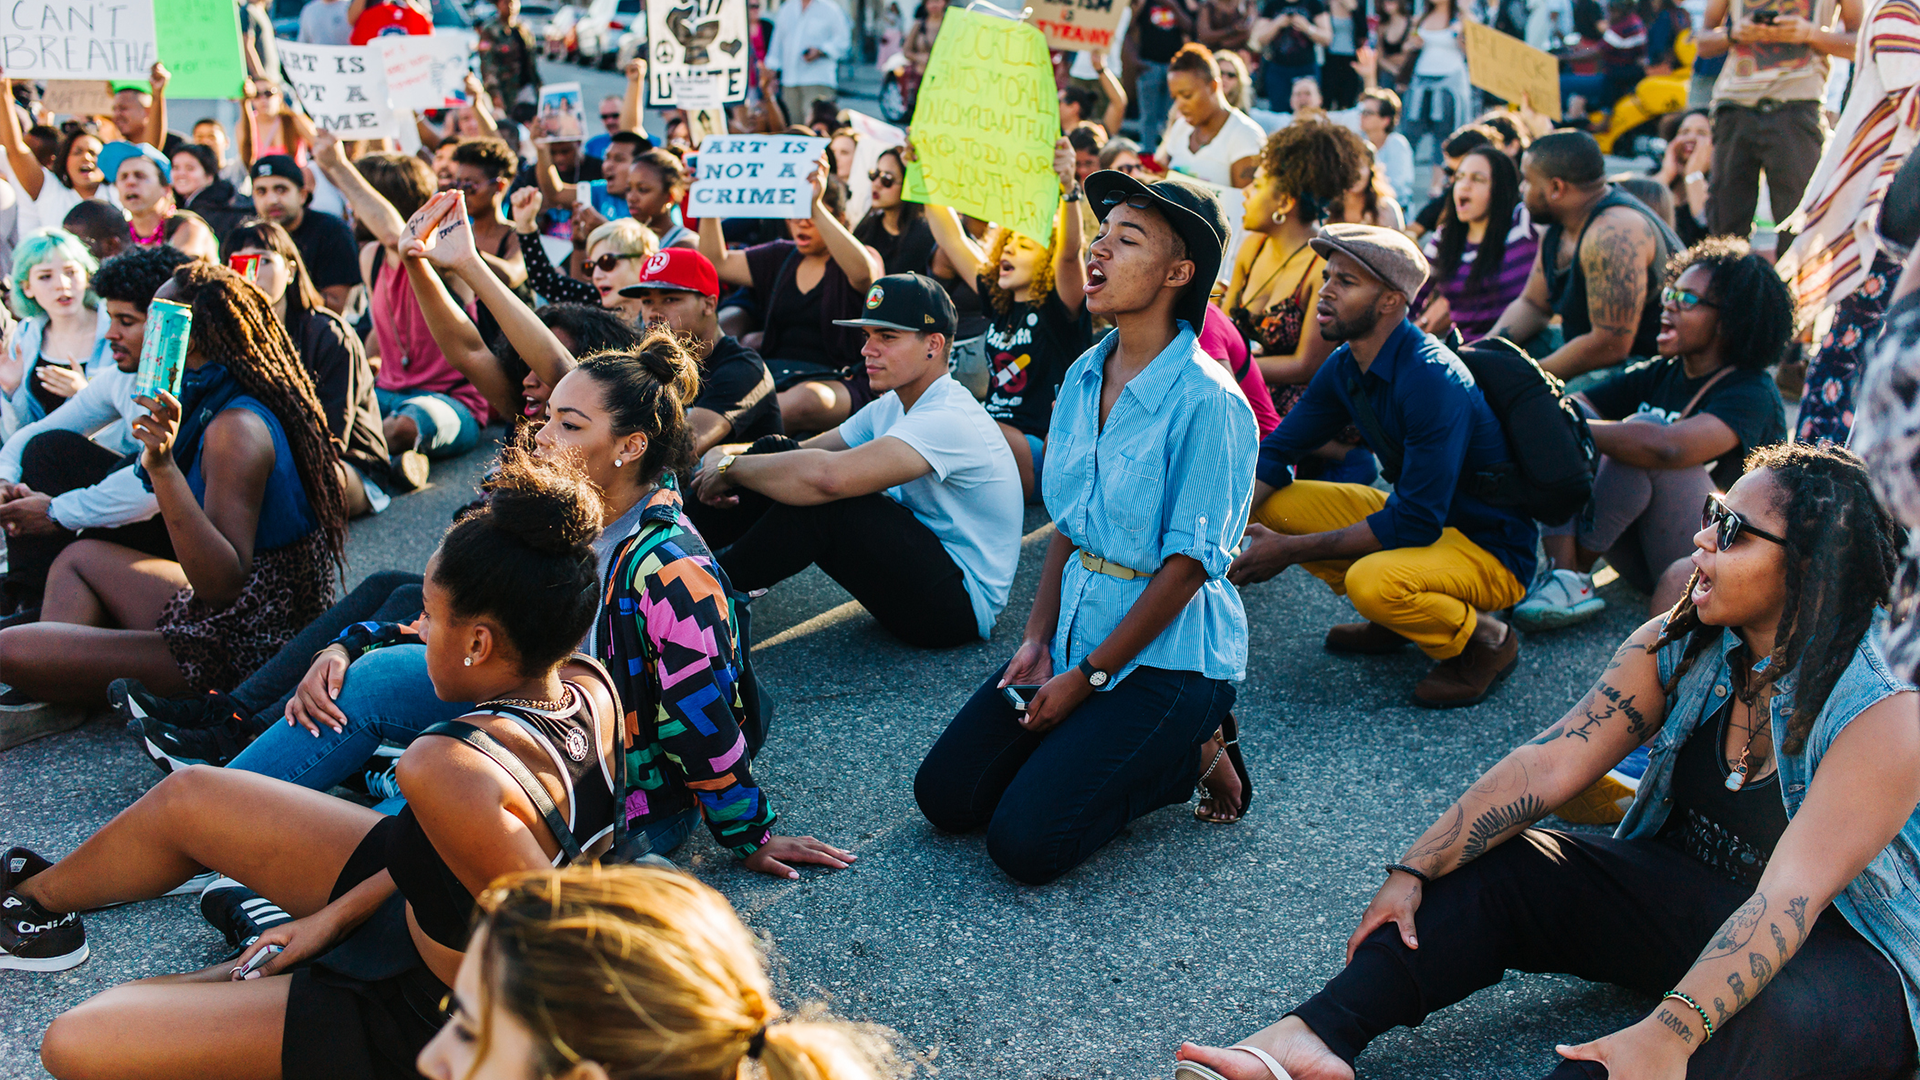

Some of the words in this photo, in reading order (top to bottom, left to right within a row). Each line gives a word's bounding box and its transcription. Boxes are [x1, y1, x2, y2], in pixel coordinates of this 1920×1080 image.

[3, 34, 154, 74] BREATHE
[334, 56, 365, 74] IS
[346, 85, 368, 103] A
[705, 140, 768, 154] ART
[780, 140, 809, 154] IS
[704, 162, 765, 180] NOT
[777, 162, 796, 178] A
[953, 159, 1014, 196] YOUTH
[694, 187, 797, 205] CRIME
